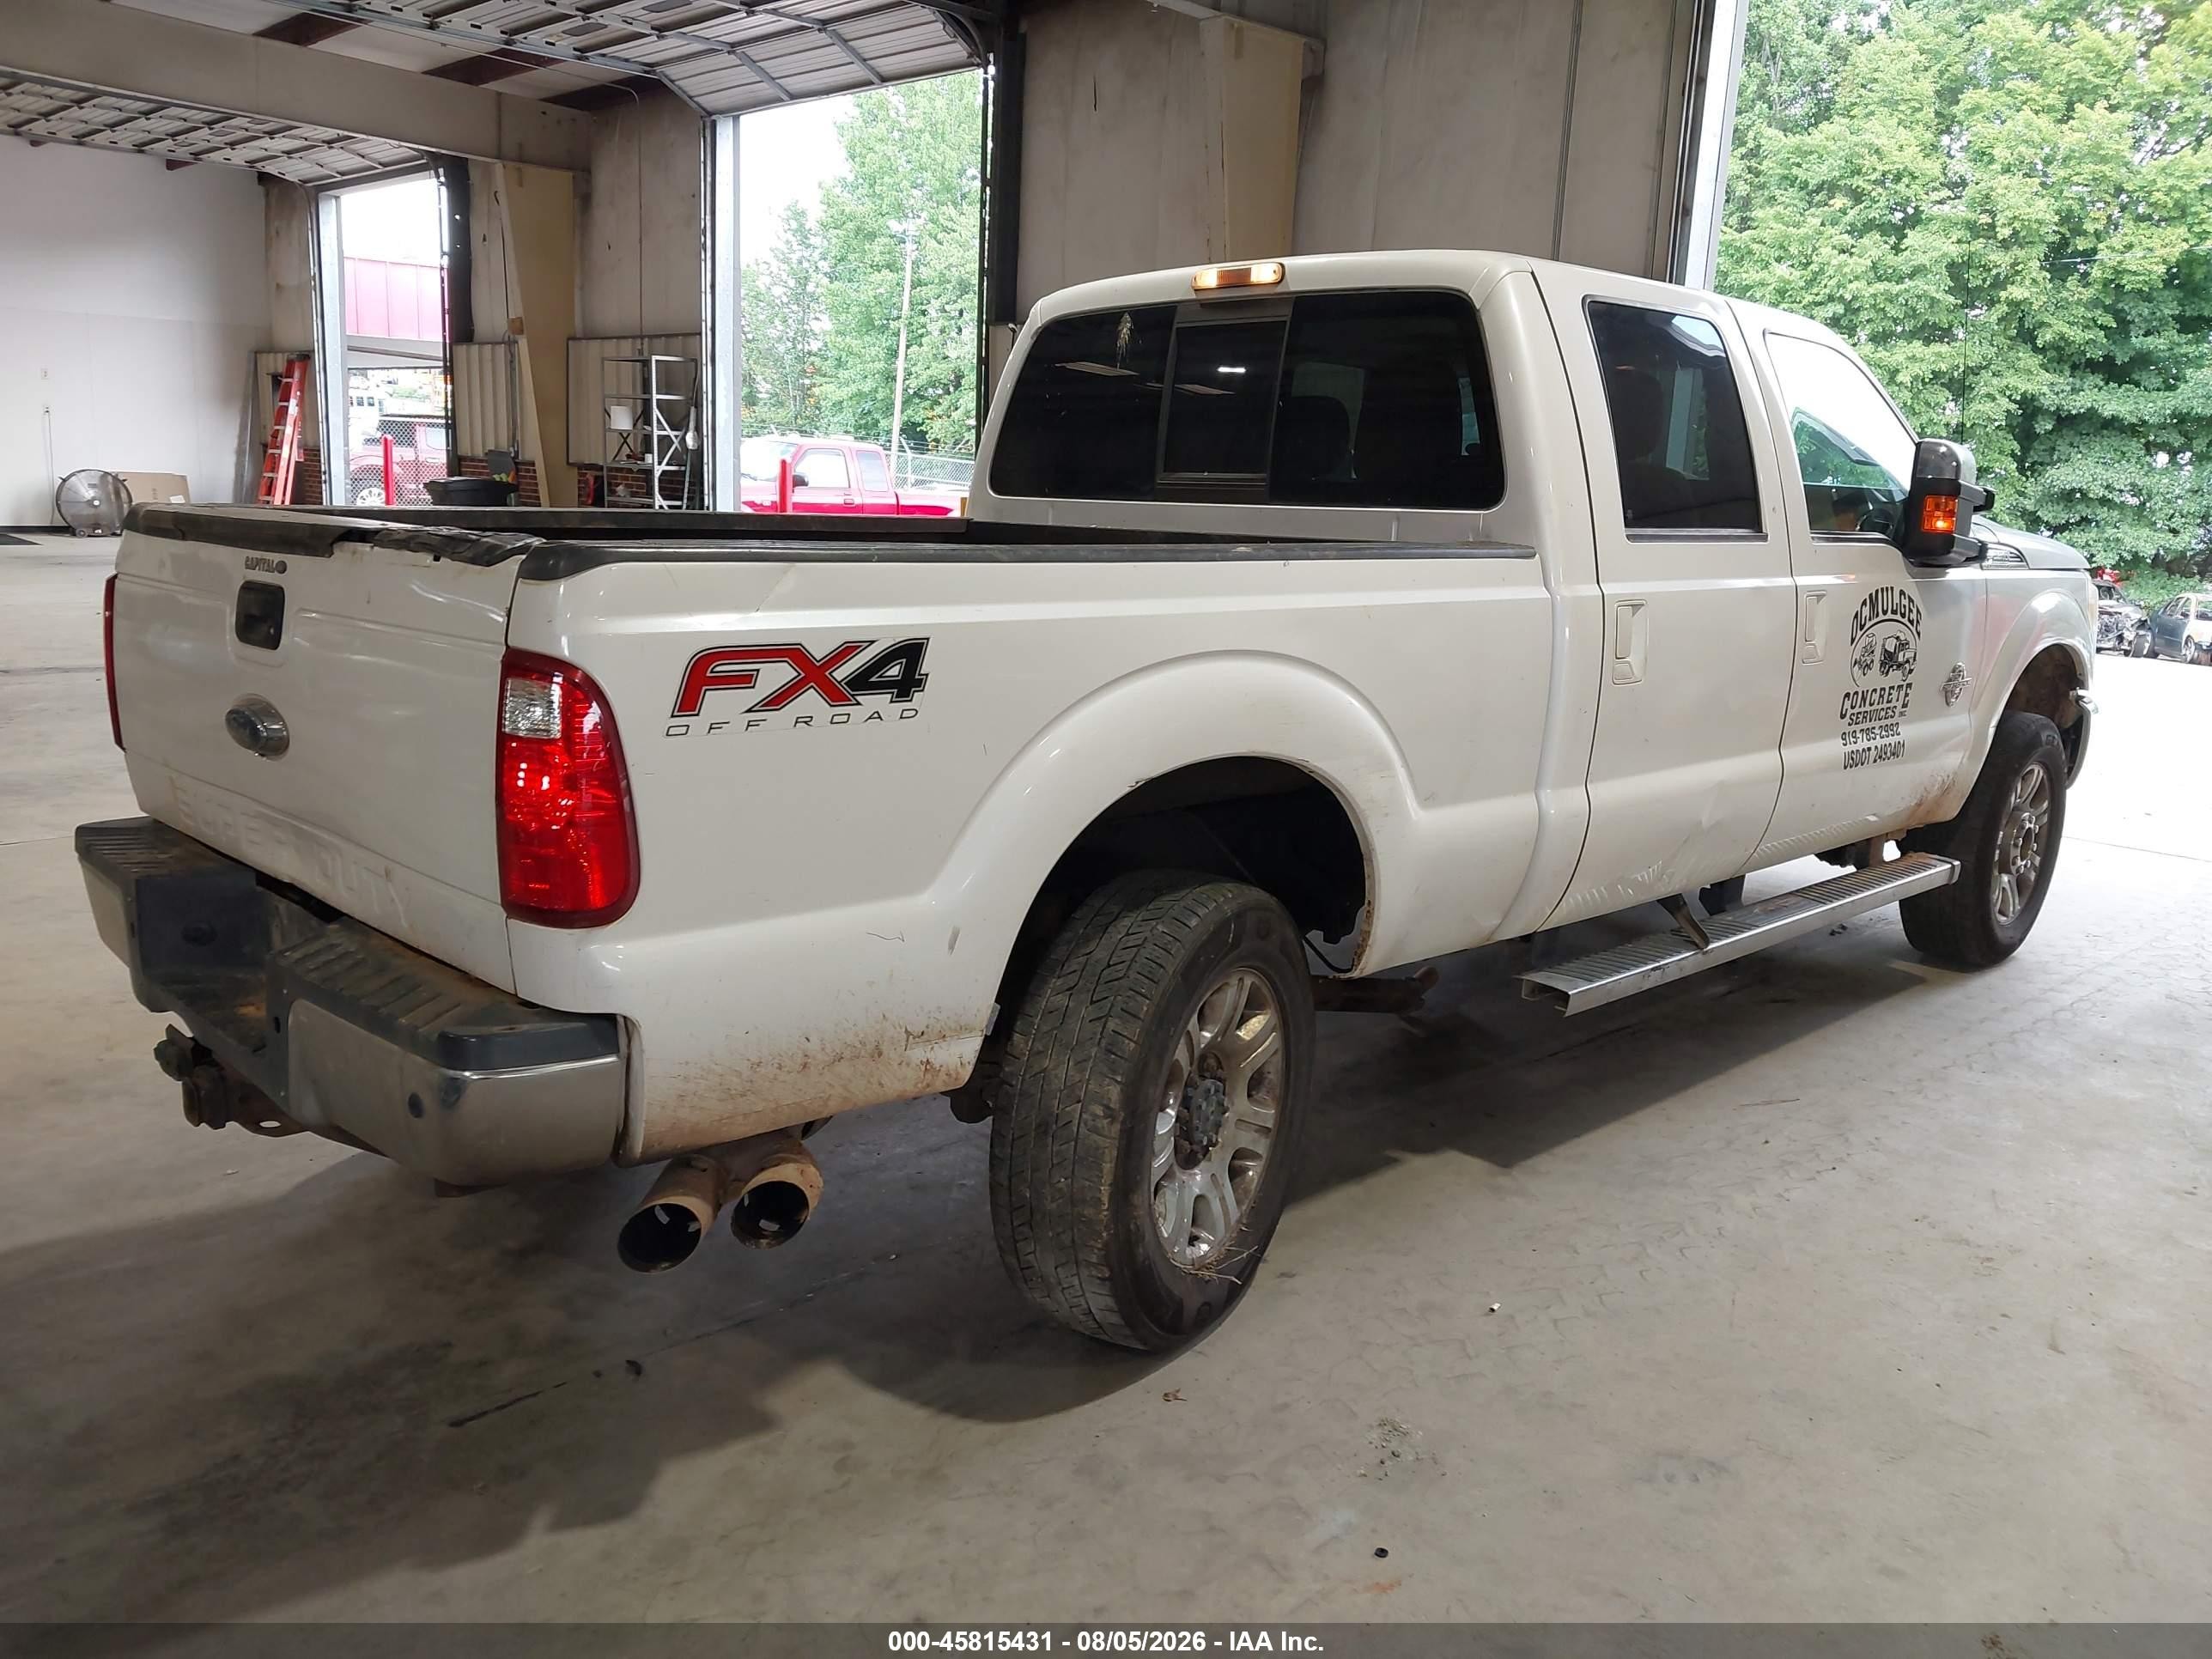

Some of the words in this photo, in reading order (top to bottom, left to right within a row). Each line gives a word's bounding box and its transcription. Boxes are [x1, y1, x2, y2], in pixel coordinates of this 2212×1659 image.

[245, 556, 275, 573] CAPITAL
[1850, 586, 1923, 646] OCMULGEE
[671, 637, 930, 718] FX4
[1840, 683, 1912, 720] CONCRETE
[1848, 706, 1897, 726] SERVICES
[665, 720, 767, 737] OFF
[793, 708, 919, 727] ROAD
[1844, 746, 1871, 769] USDOT
[1873, 740, 1905, 764] 2493401
